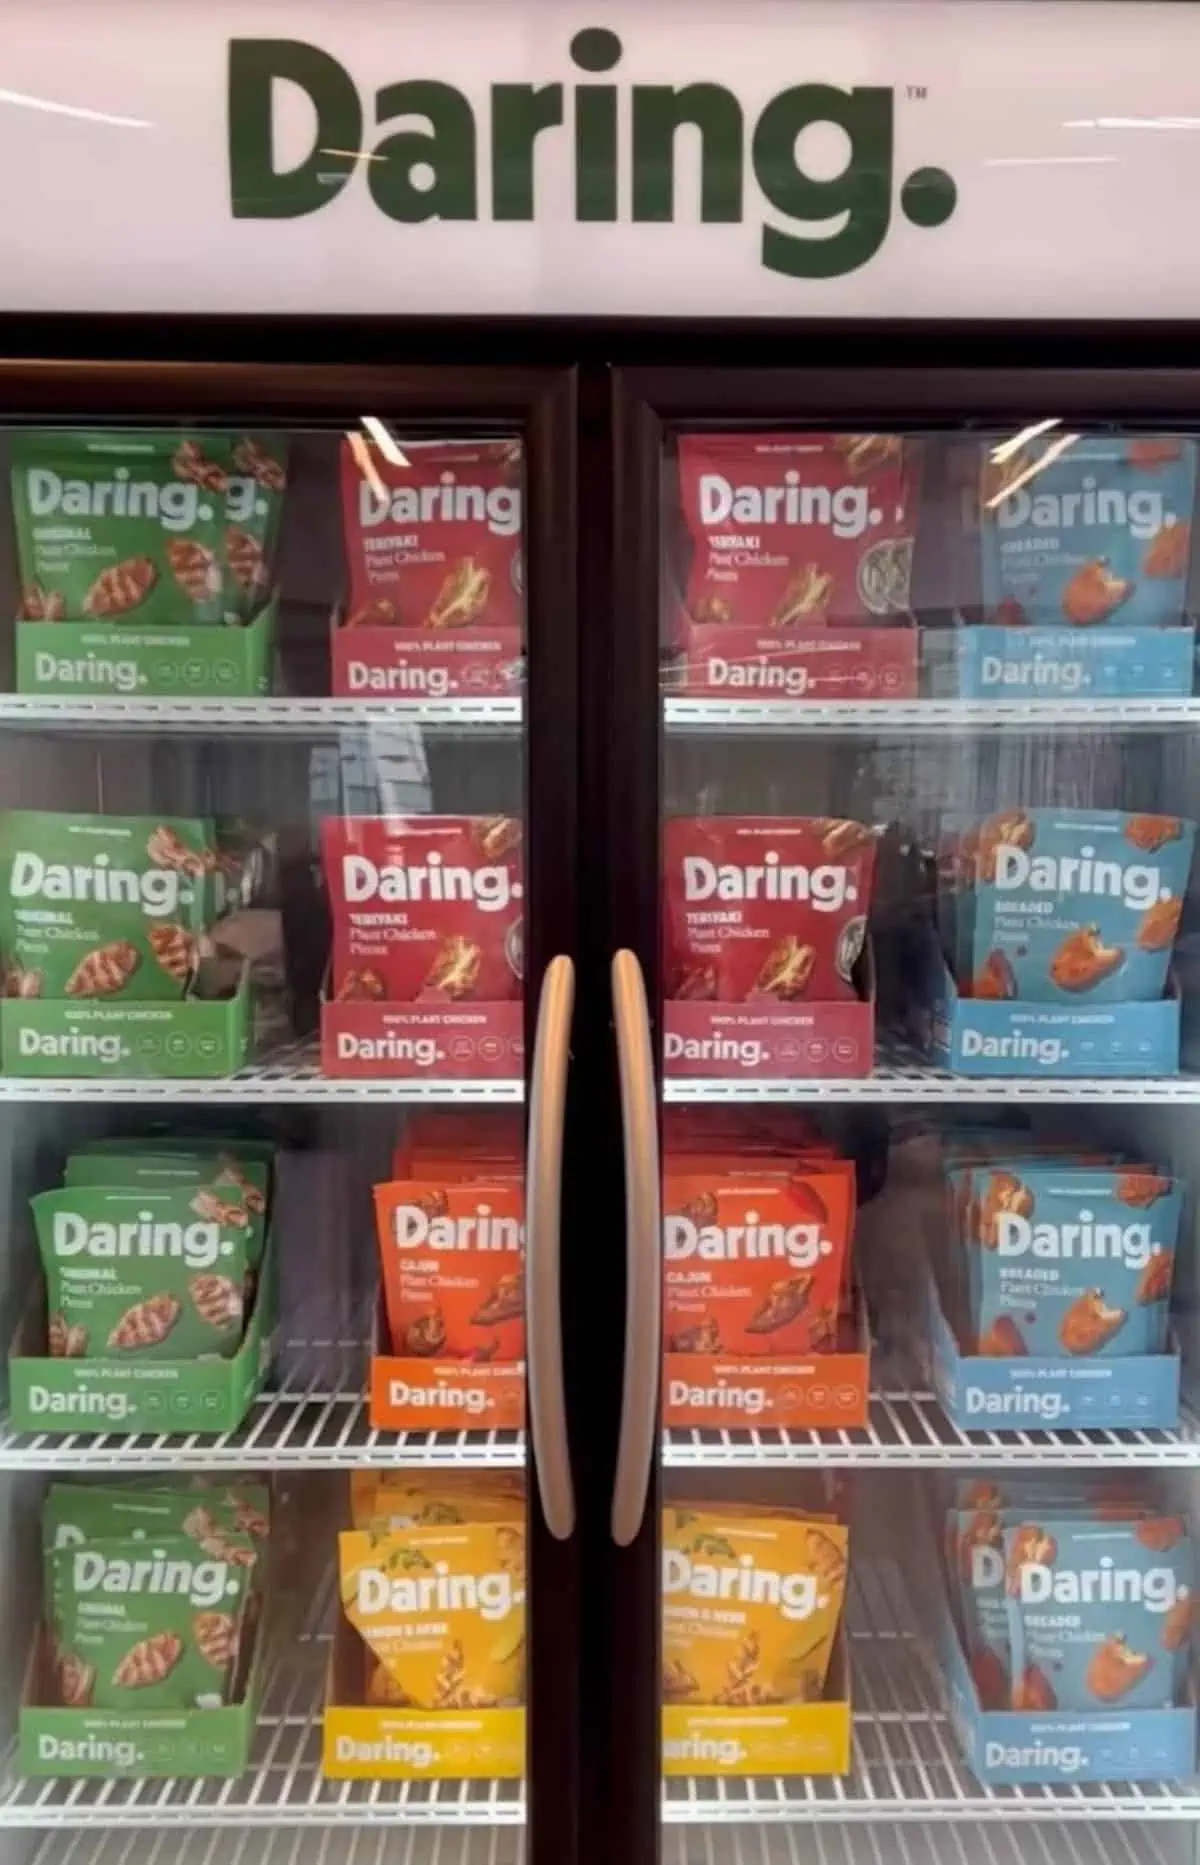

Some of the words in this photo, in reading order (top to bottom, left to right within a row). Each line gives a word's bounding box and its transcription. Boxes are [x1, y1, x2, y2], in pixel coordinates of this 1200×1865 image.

[228, 26, 957, 279] Daring.
[27, 467, 214, 532] Daring.
[699, 470, 883, 538] Daring.
[998, 477, 1177, 539] Daring.
[35, 652, 148, 691] Daring.
[348, 659, 460, 696] Daring.
[708, 656, 816, 695] Daring.
[981, 653, 1092, 690] Daring.
[10, 851, 195, 917] Daring.
[343, 851, 523, 912] Daring.
[683, 851, 858, 912] Daring.
[995, 844, 1172, 910] Daring.
[19, 1027, 130, 1063] Daring.
[337, 1031, 445, 1067] Daring.
[664, 1031, 770, 1067] Daring.
[962, 1029, 1069, 1064] Daring.
[53, 1210, 234, 1268] Daring.
[395, 1204, 525, 1254] Darin
[664, 1210, 832, 1268] Daring.
[996, 1208, 1161, 1270] Daring.
[29, 1385, 138, 1420] Daring.
[389, 1379, 496, 1413] Daring.
[669, 1378, 773, 1415] Daring.
[965, 1386, 1071, 1420] Daring.
[73, 1549, 240, 1607] Daring.
[358, 1560, 525, 1621] Daring.
[663, 1550, 830, 1620] Daring.
[1020, 1556, 1189, 1612] Daring.
[38, 1733, 144, 1766] Daring.
[336, 1735, 440, 1768] Daring.
[985, 1739, 1090, 1772] Daring.
